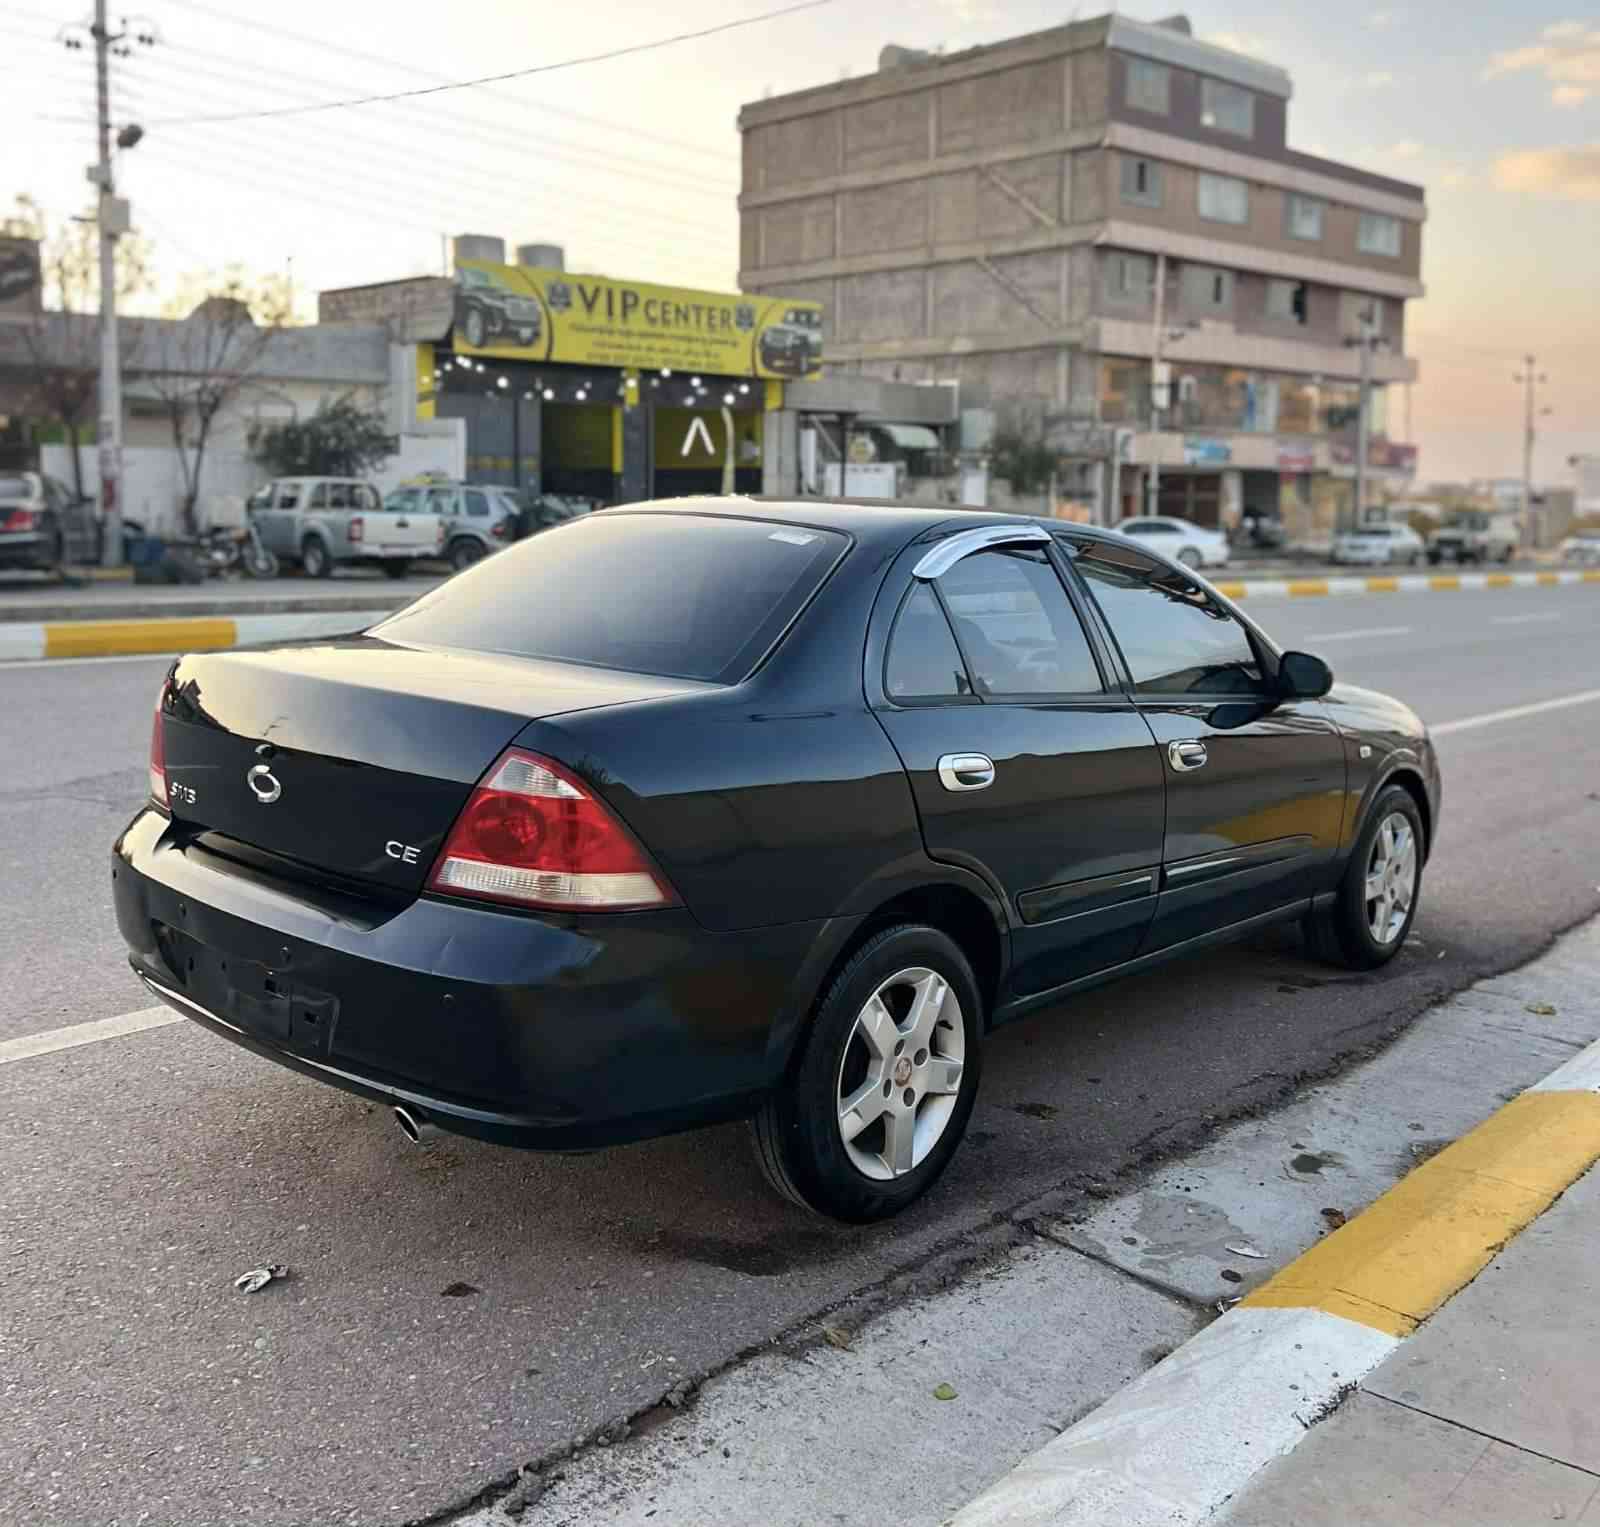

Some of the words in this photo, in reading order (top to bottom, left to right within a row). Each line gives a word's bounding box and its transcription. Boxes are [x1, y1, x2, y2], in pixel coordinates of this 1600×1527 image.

[577, 285, 640, 323] VIP
[645, 300, 732, 330] CENTER
[169, 782, 197, 804] SM3
[384, 840, 421, 864] CE
